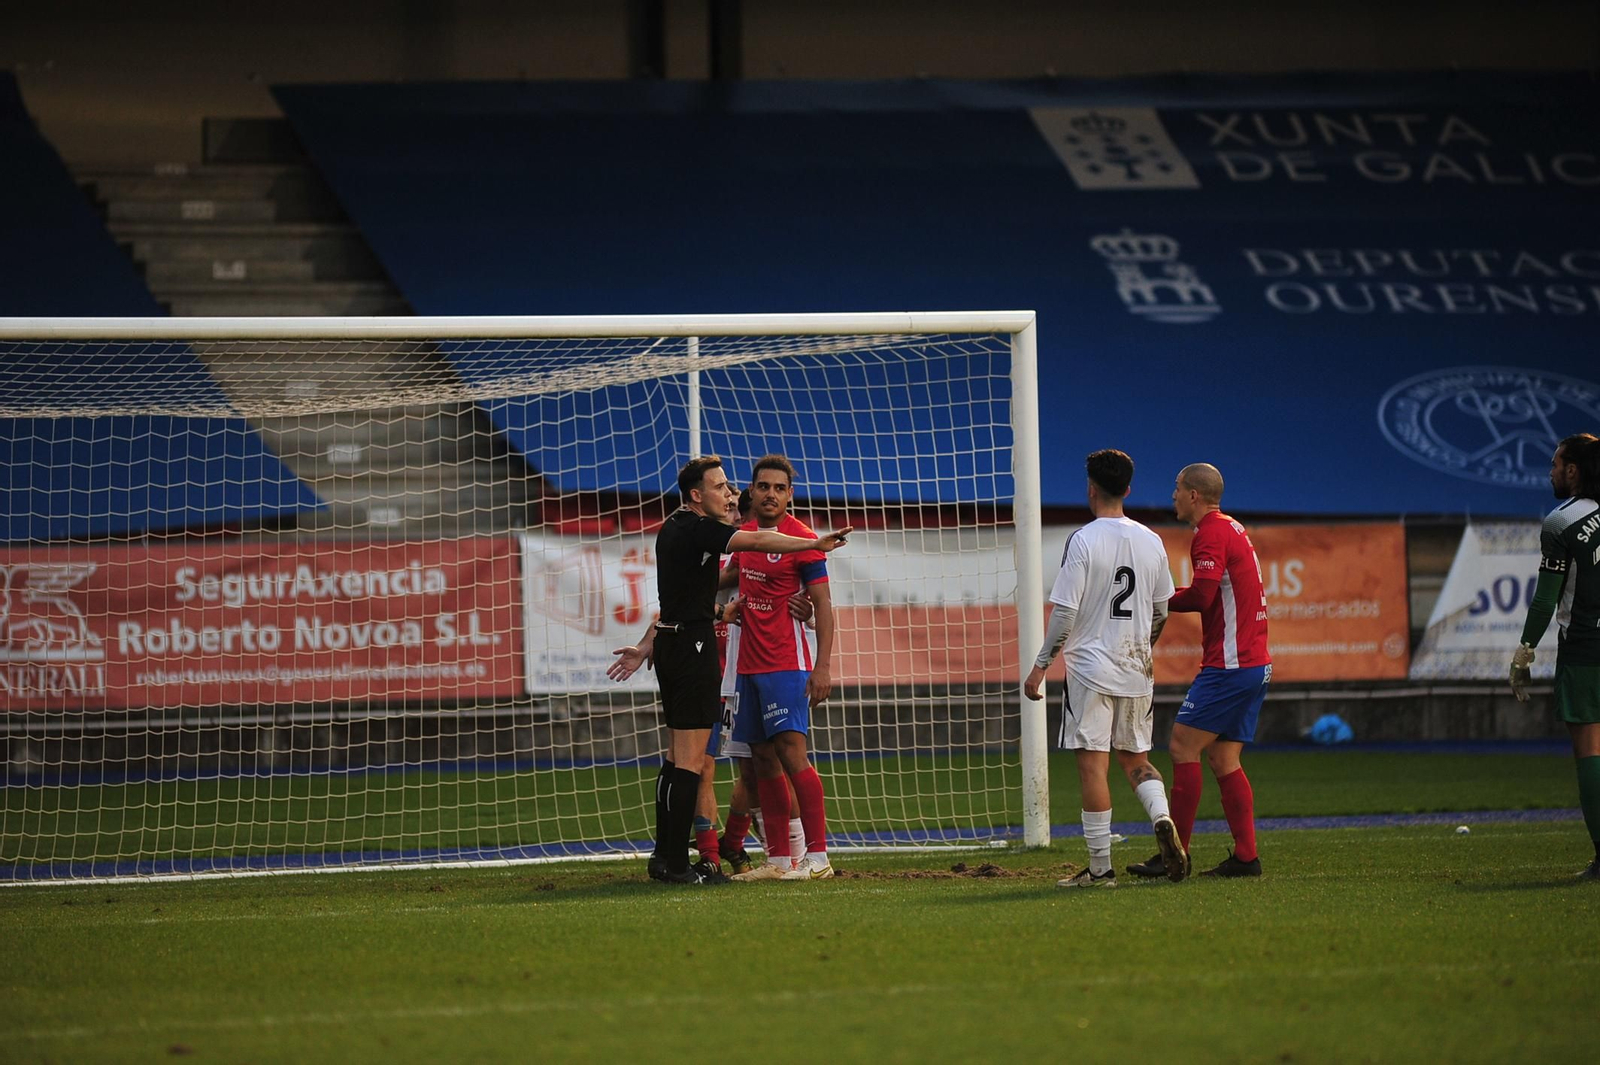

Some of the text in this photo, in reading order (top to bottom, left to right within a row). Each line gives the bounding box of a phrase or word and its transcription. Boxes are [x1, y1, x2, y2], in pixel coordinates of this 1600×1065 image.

[1196, 113, 1492, 147] XUNTA
[1214, 150, 1600, 186] DE GALIC
[1242, 247, 1600, 279] DEPUTAC
[1264, 281, 1600, 315] OURENS
[175, 563, 447, 608] SegurAxencia
[1110, 566, 1135, 620] 2
[747, 602, 773, 611] OSAGA
[118, 611, 501, 655] Roberto Novoa S.L.
[767, 702, 778, 711] BAR
